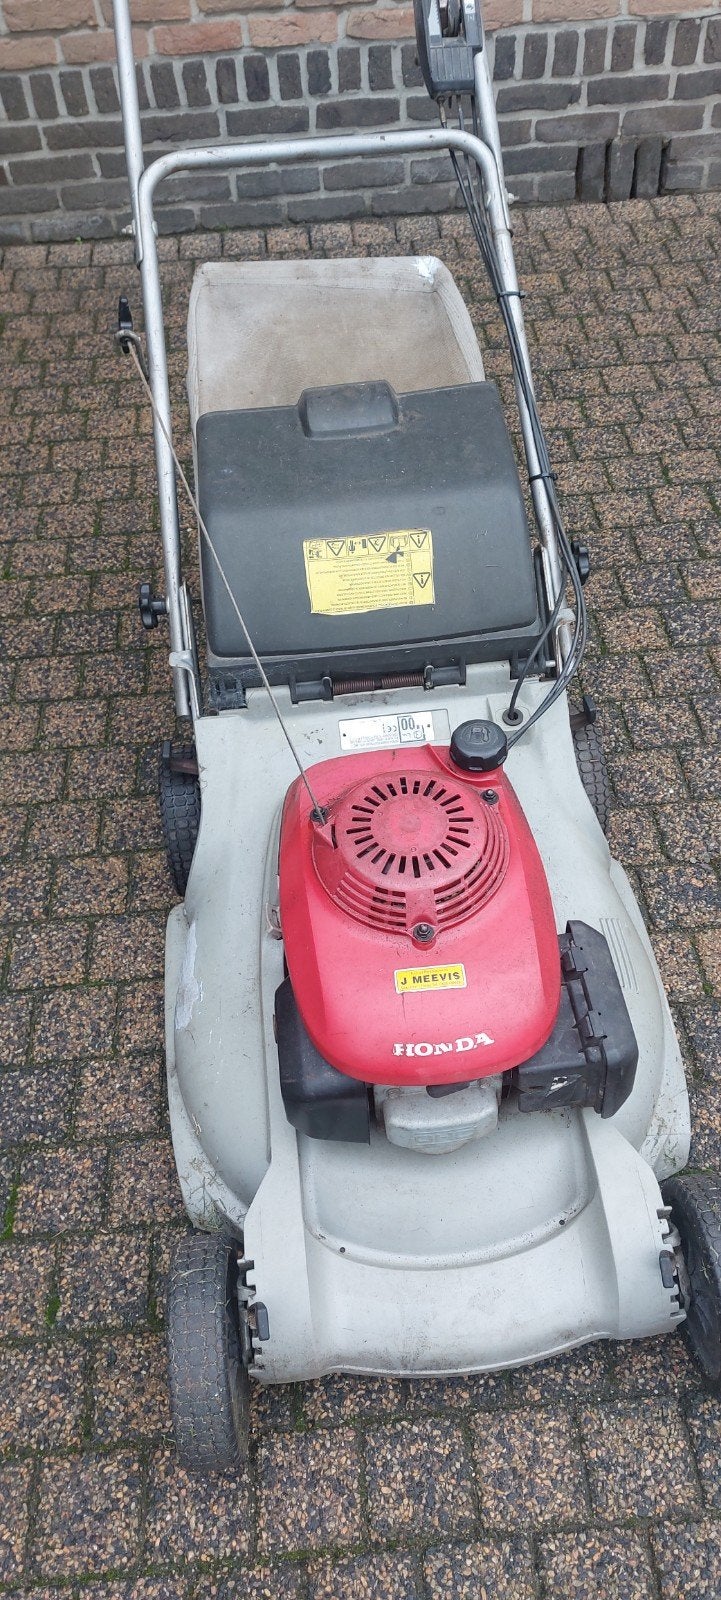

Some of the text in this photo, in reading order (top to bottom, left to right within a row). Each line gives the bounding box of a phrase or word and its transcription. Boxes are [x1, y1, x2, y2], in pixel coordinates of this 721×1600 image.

[400, 977, 408, 986] J
[412, 971, 460, 984] MEEVIS
[392, 1032, 495, 1057] HONDA
